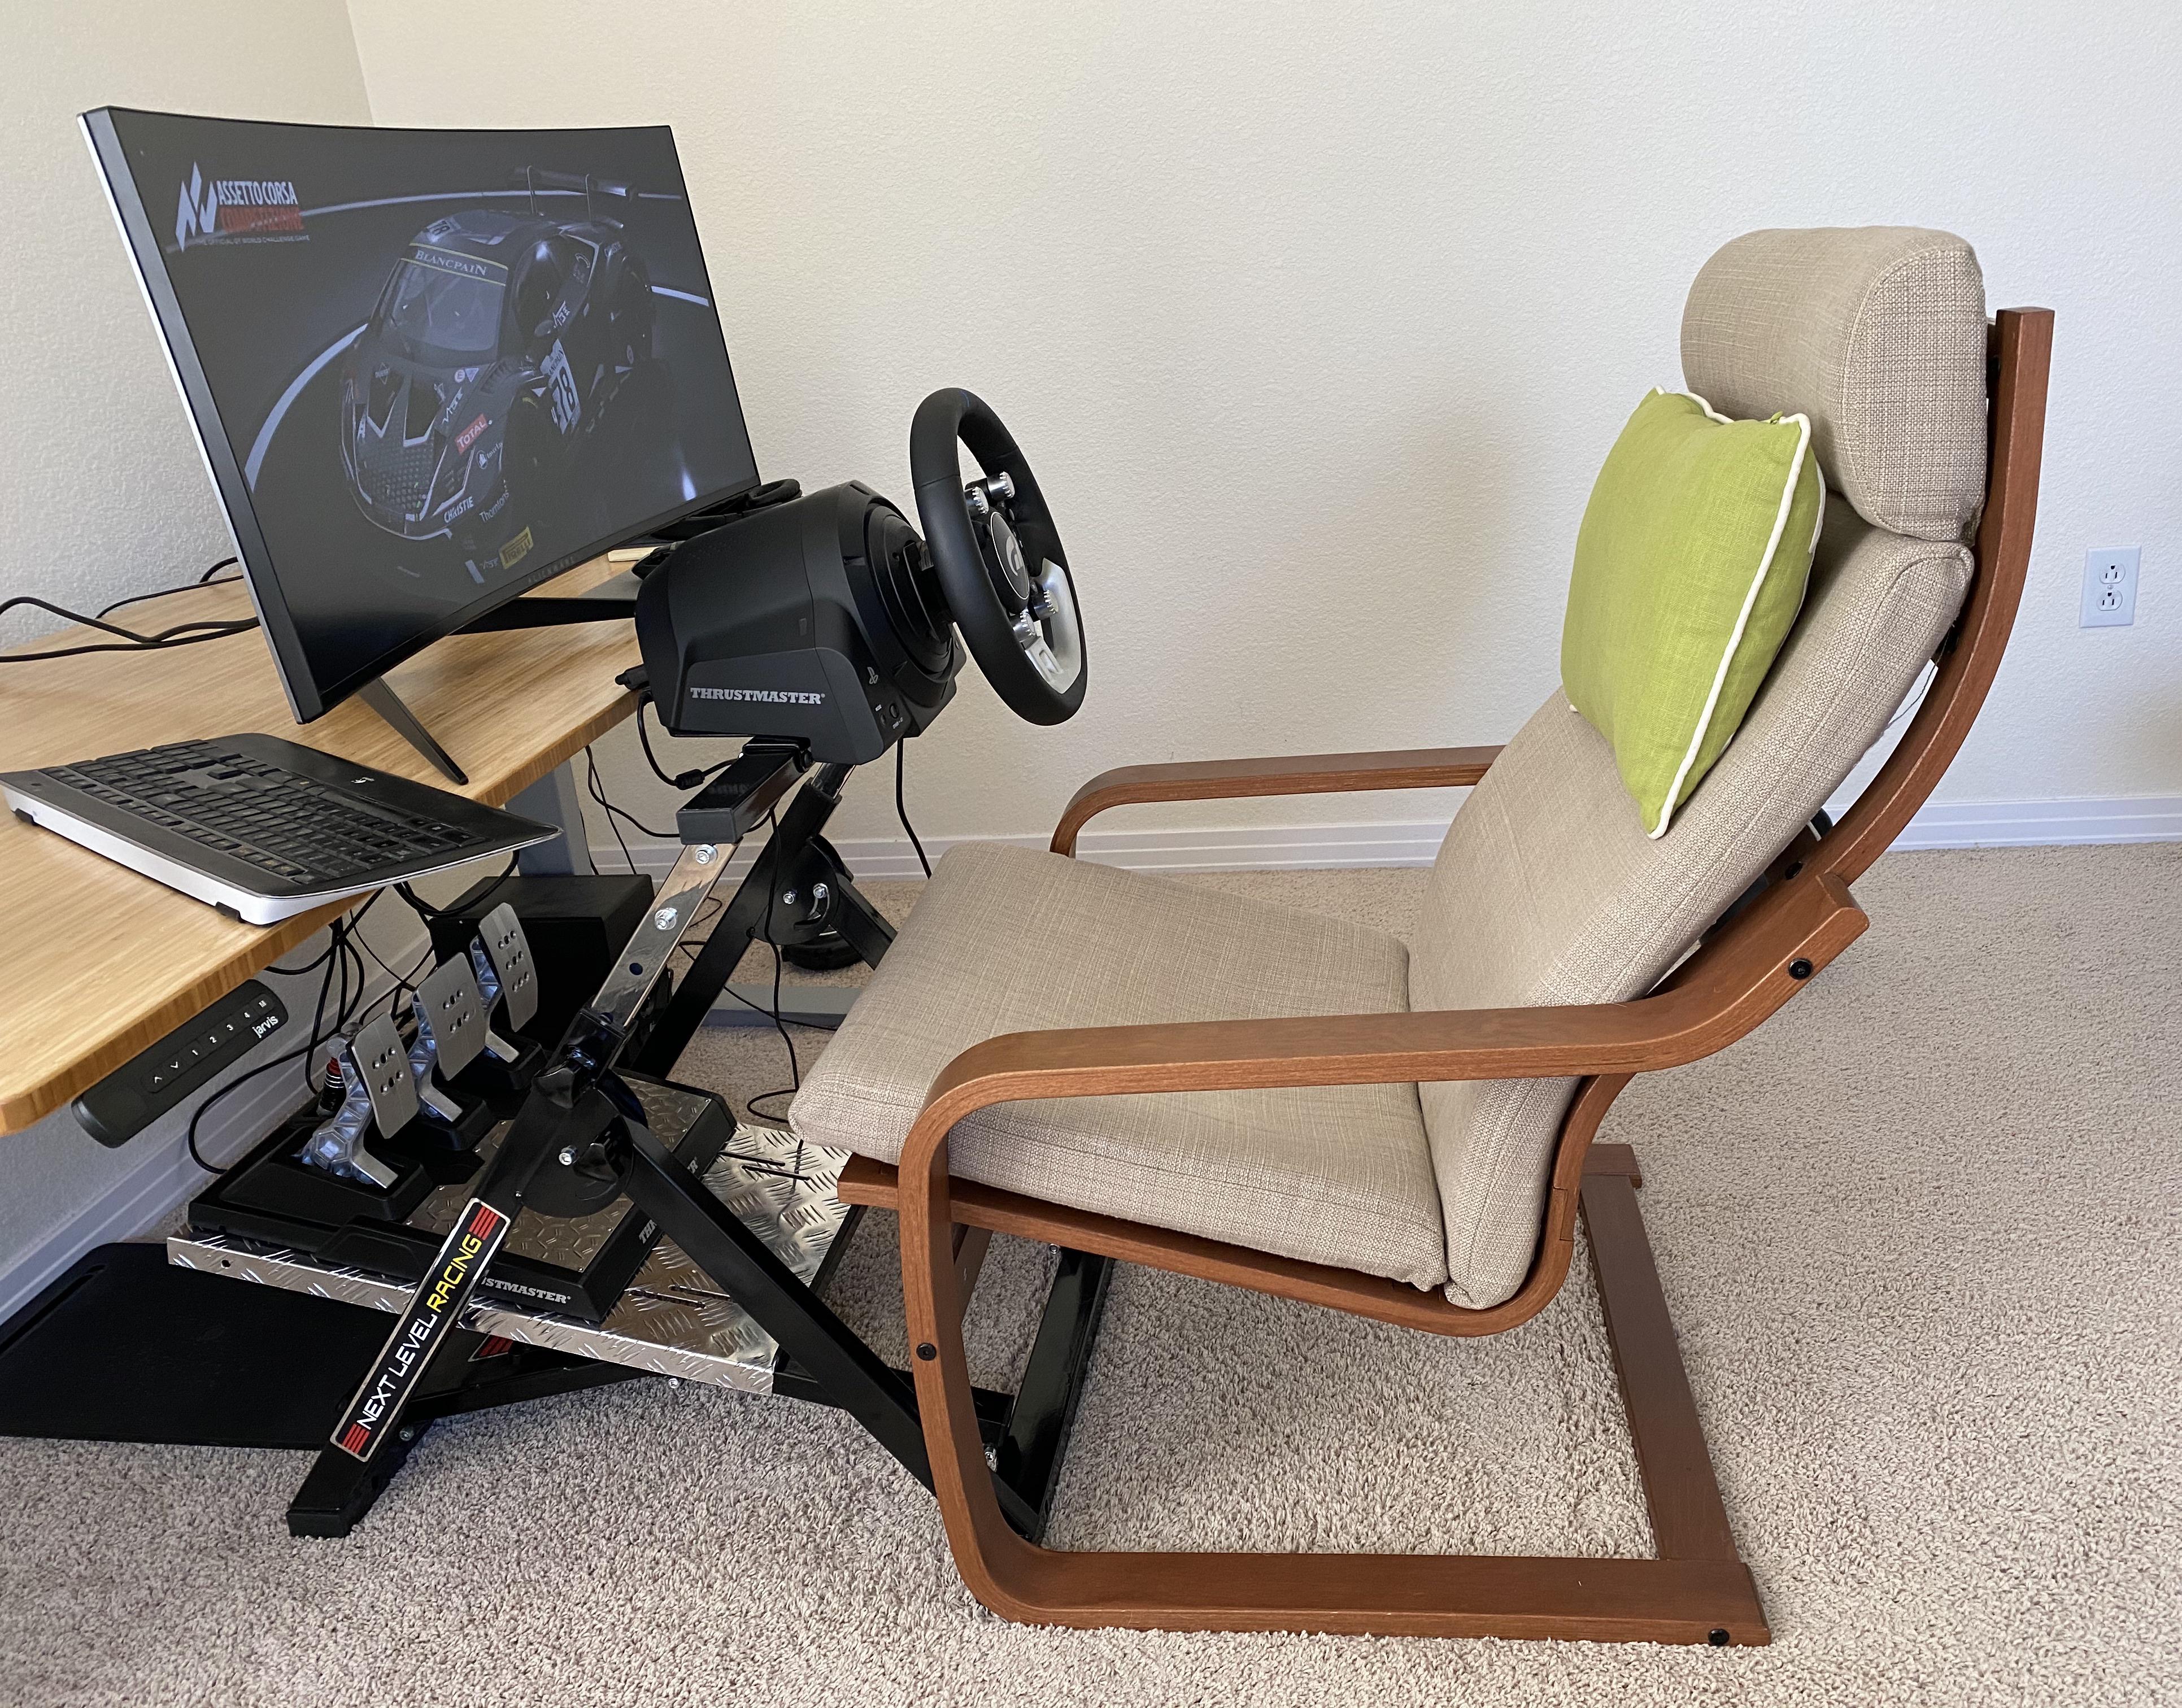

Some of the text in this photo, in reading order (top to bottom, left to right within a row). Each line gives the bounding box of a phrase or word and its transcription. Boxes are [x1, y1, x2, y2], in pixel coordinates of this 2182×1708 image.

[216, 181, 299, 205] ASSETTO CORSA
[415, 250, 487, 276] BLANCPAIN
[457, 420, 486, 448] TOTAL
[443, 496, 474, 524] CHRISTIE
[690, 687, 822, 705] THRUSTMASTER
[251, 1016, 278, 1039] jarvis
[356, 1233, 482, 1431] NEXT LEVEL RACING
